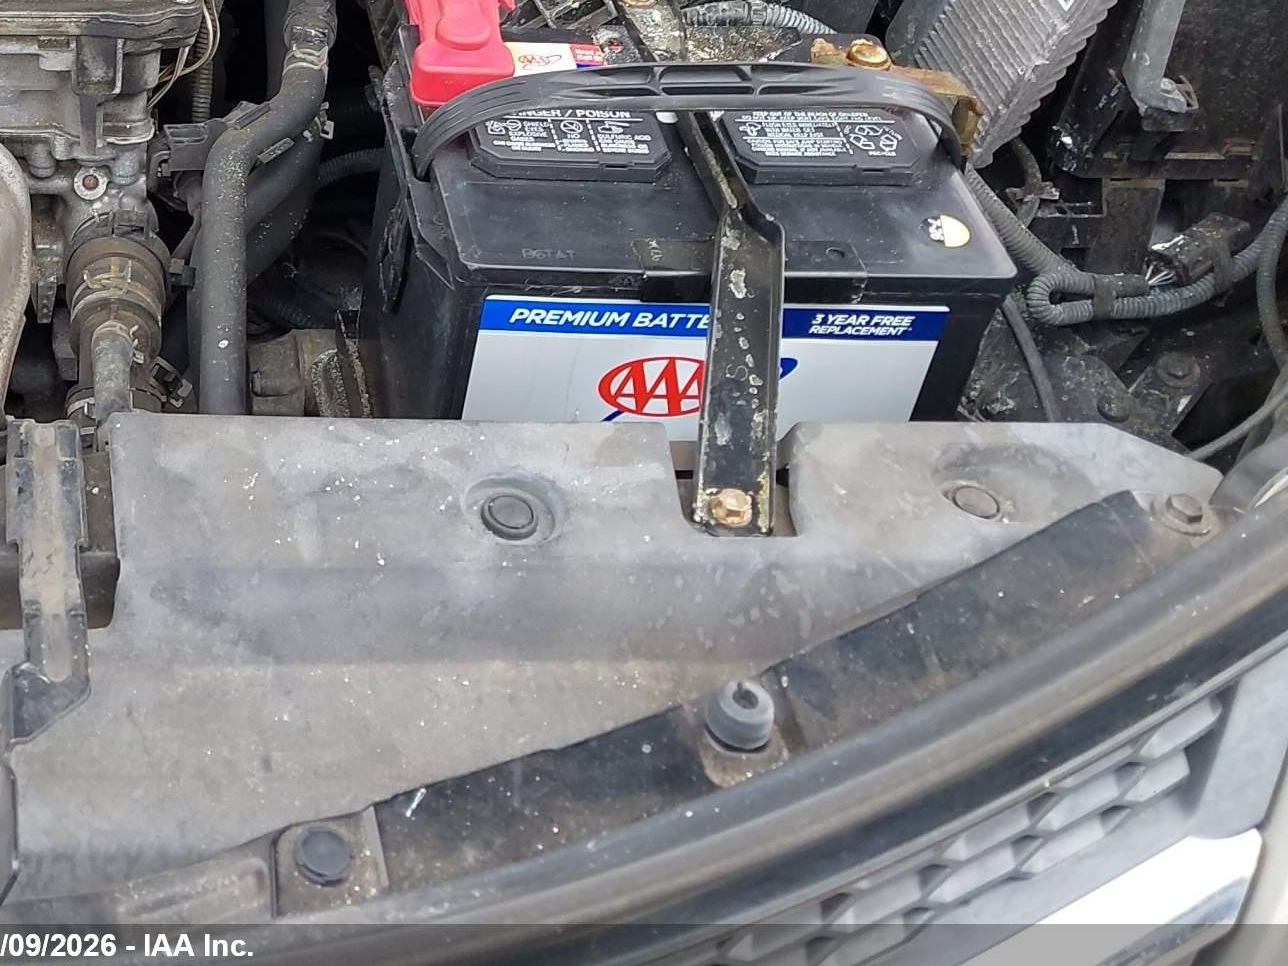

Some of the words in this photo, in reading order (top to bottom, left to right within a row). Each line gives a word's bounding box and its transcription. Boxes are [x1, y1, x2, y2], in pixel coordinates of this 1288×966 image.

[575, 109, 631, 118] POISON
[509, 307, 625, 328] PREMIUM
[632, 312, 710, 330] BATTE
[812, 314, 825, 325] 3
[826, 314, 871, 326] YEAR
[870, 315, 916, 327] FREE
